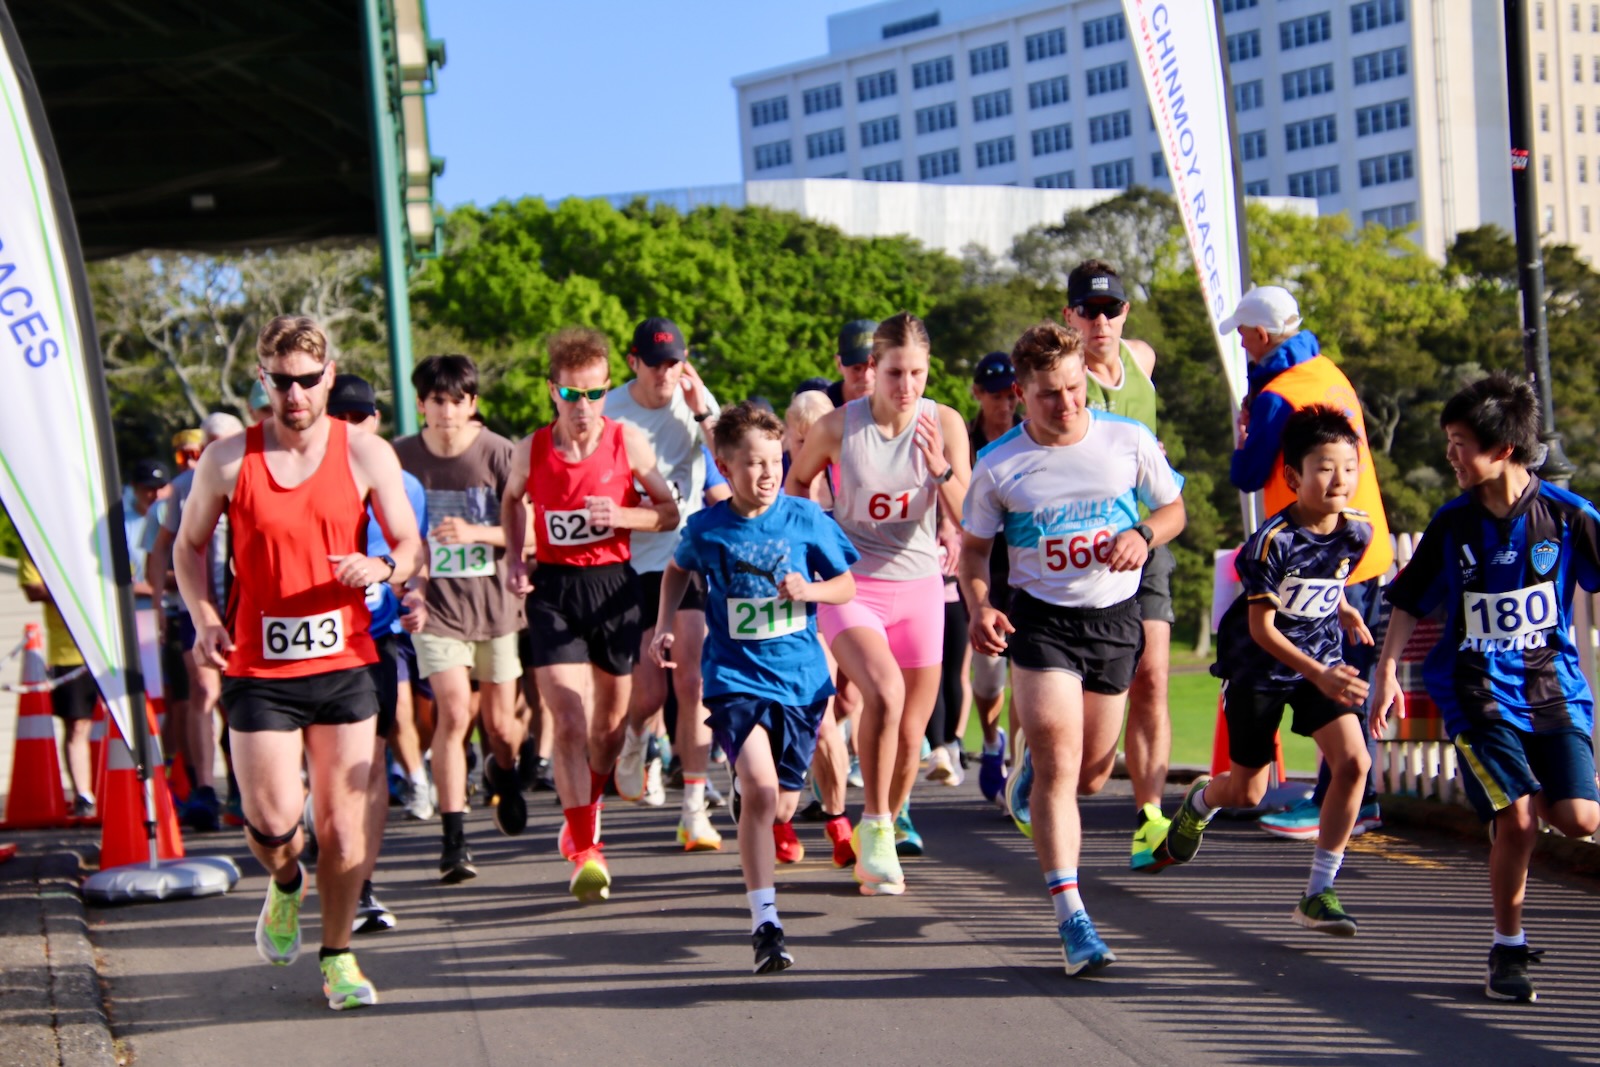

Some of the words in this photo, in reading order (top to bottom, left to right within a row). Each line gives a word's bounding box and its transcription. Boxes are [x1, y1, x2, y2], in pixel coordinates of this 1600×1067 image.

[1152, 3, 1201, 176] CHINMOY
[1193, 189, 1225, 320] RACES
[869, 493, 909, 520] 61
[1033, 497, 1117, 527] INFINITY
[435, 546, 487, 572] 213
[1046, 530, 1111, 571] 566
[1285, 583, 1340, 613] 179
[1471, 590, 1550, 634] 180
[736, 600, 793, 634] 211
[266, 618, 338, 654] 643
